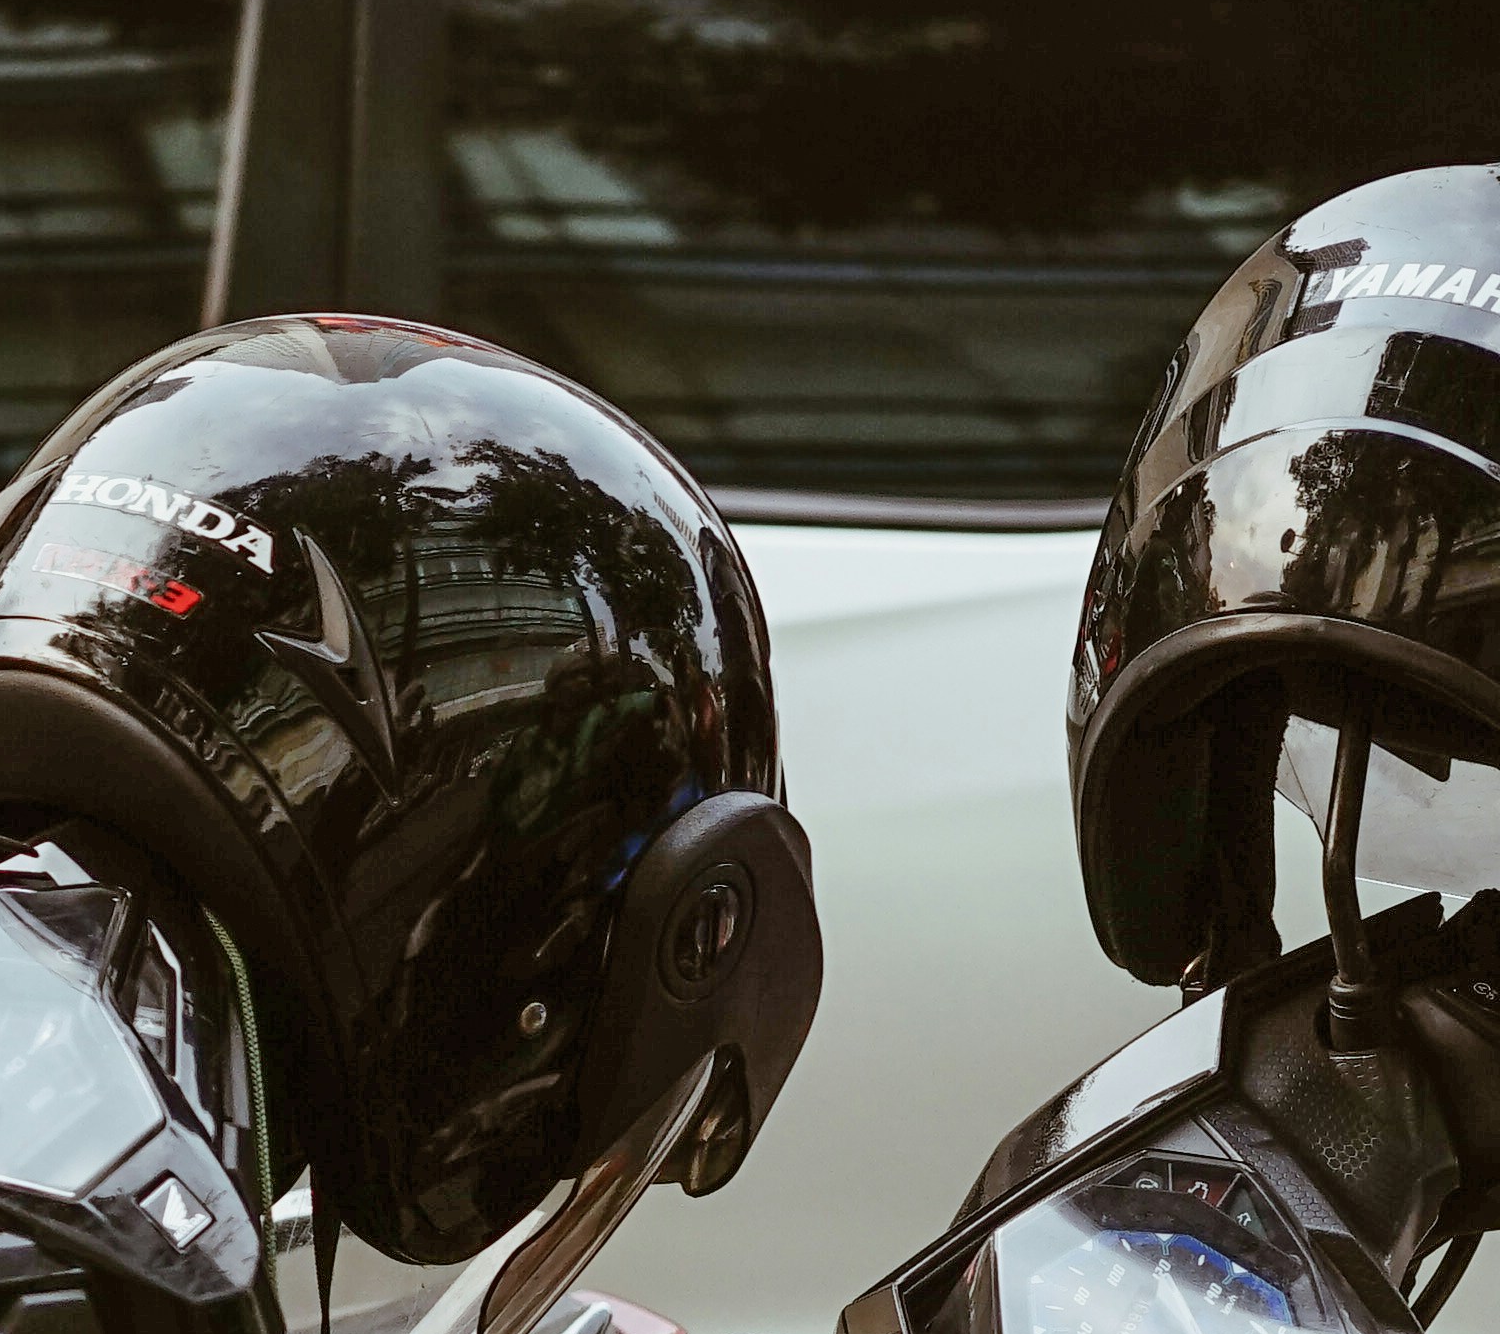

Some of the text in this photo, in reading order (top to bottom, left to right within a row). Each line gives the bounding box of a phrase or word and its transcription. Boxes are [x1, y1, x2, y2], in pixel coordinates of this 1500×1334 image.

[49, 474, 274, 575] HONDA
[1106, 1264, 1126, 1287] 100
[1073, 1286, 1090, 1306] 80
